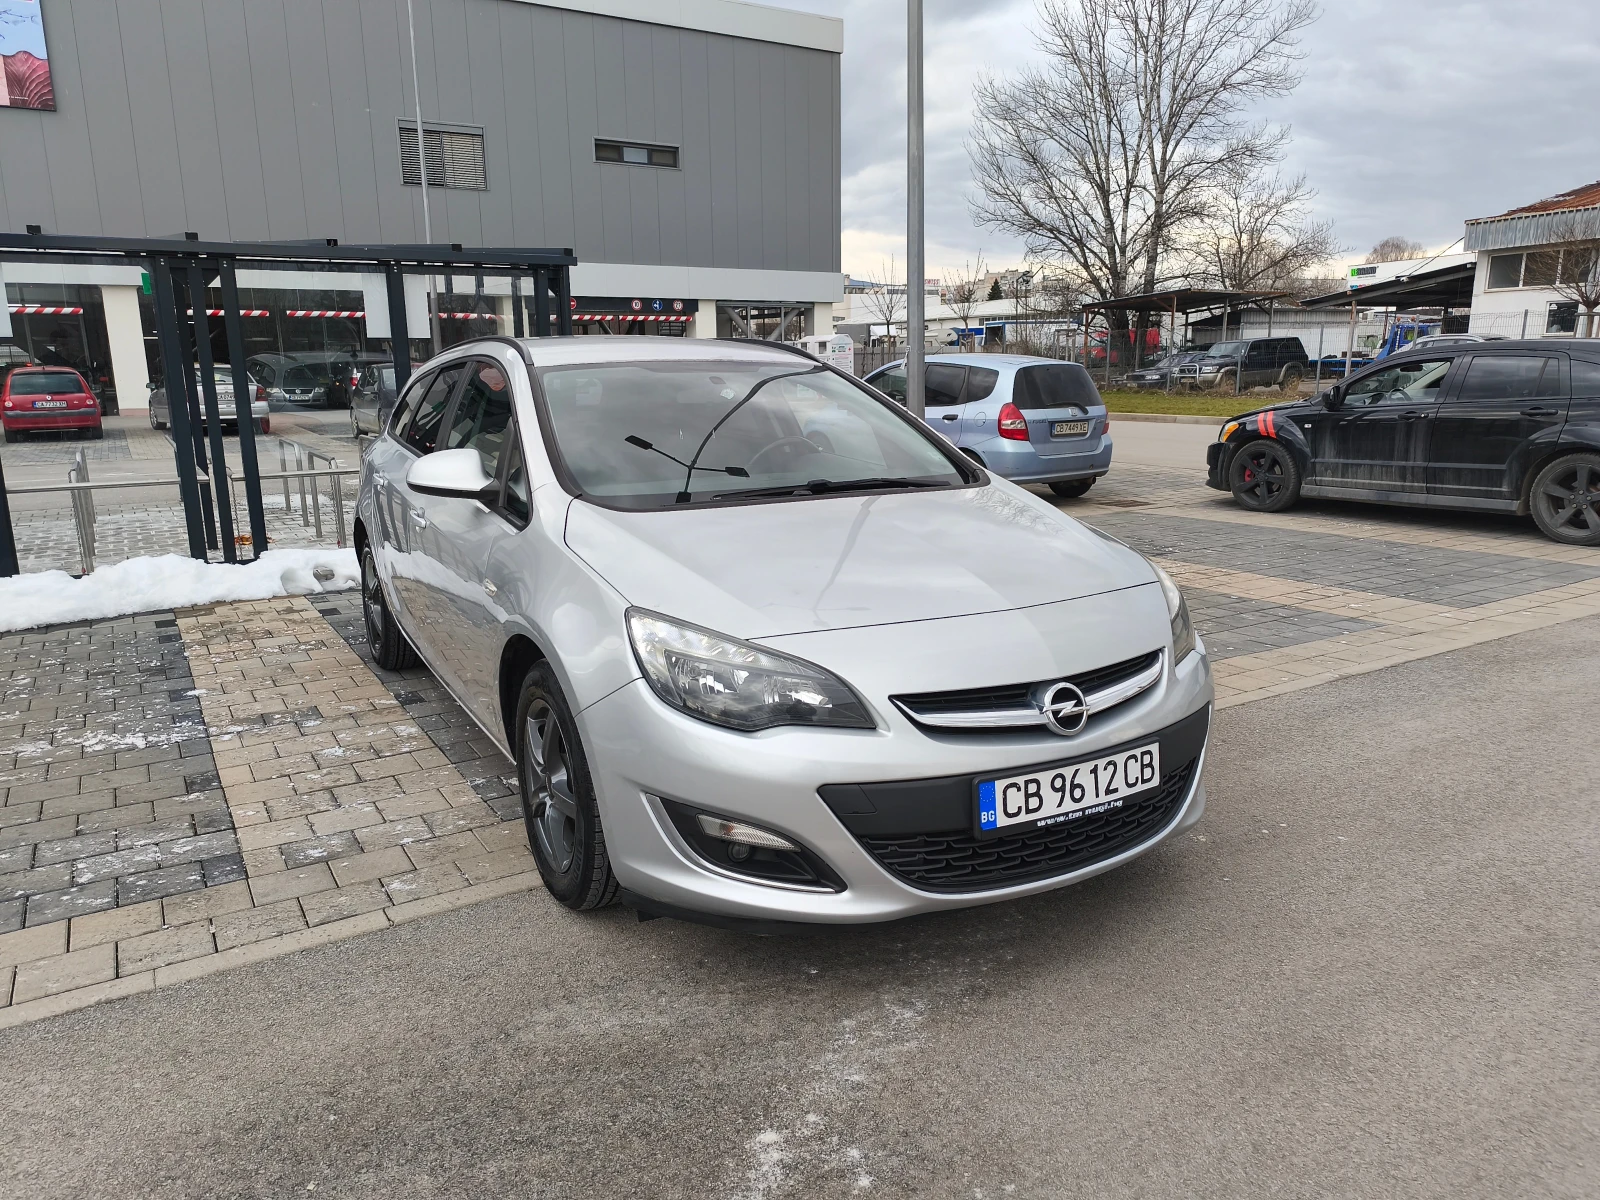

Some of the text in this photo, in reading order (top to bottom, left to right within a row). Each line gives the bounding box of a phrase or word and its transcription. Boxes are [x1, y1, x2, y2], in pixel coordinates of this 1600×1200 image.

[1056, 424, 1064, 432] CB
[1002, 749, 1155, 819] CB 9612 CB
[981, 811, 995, 823] BG
